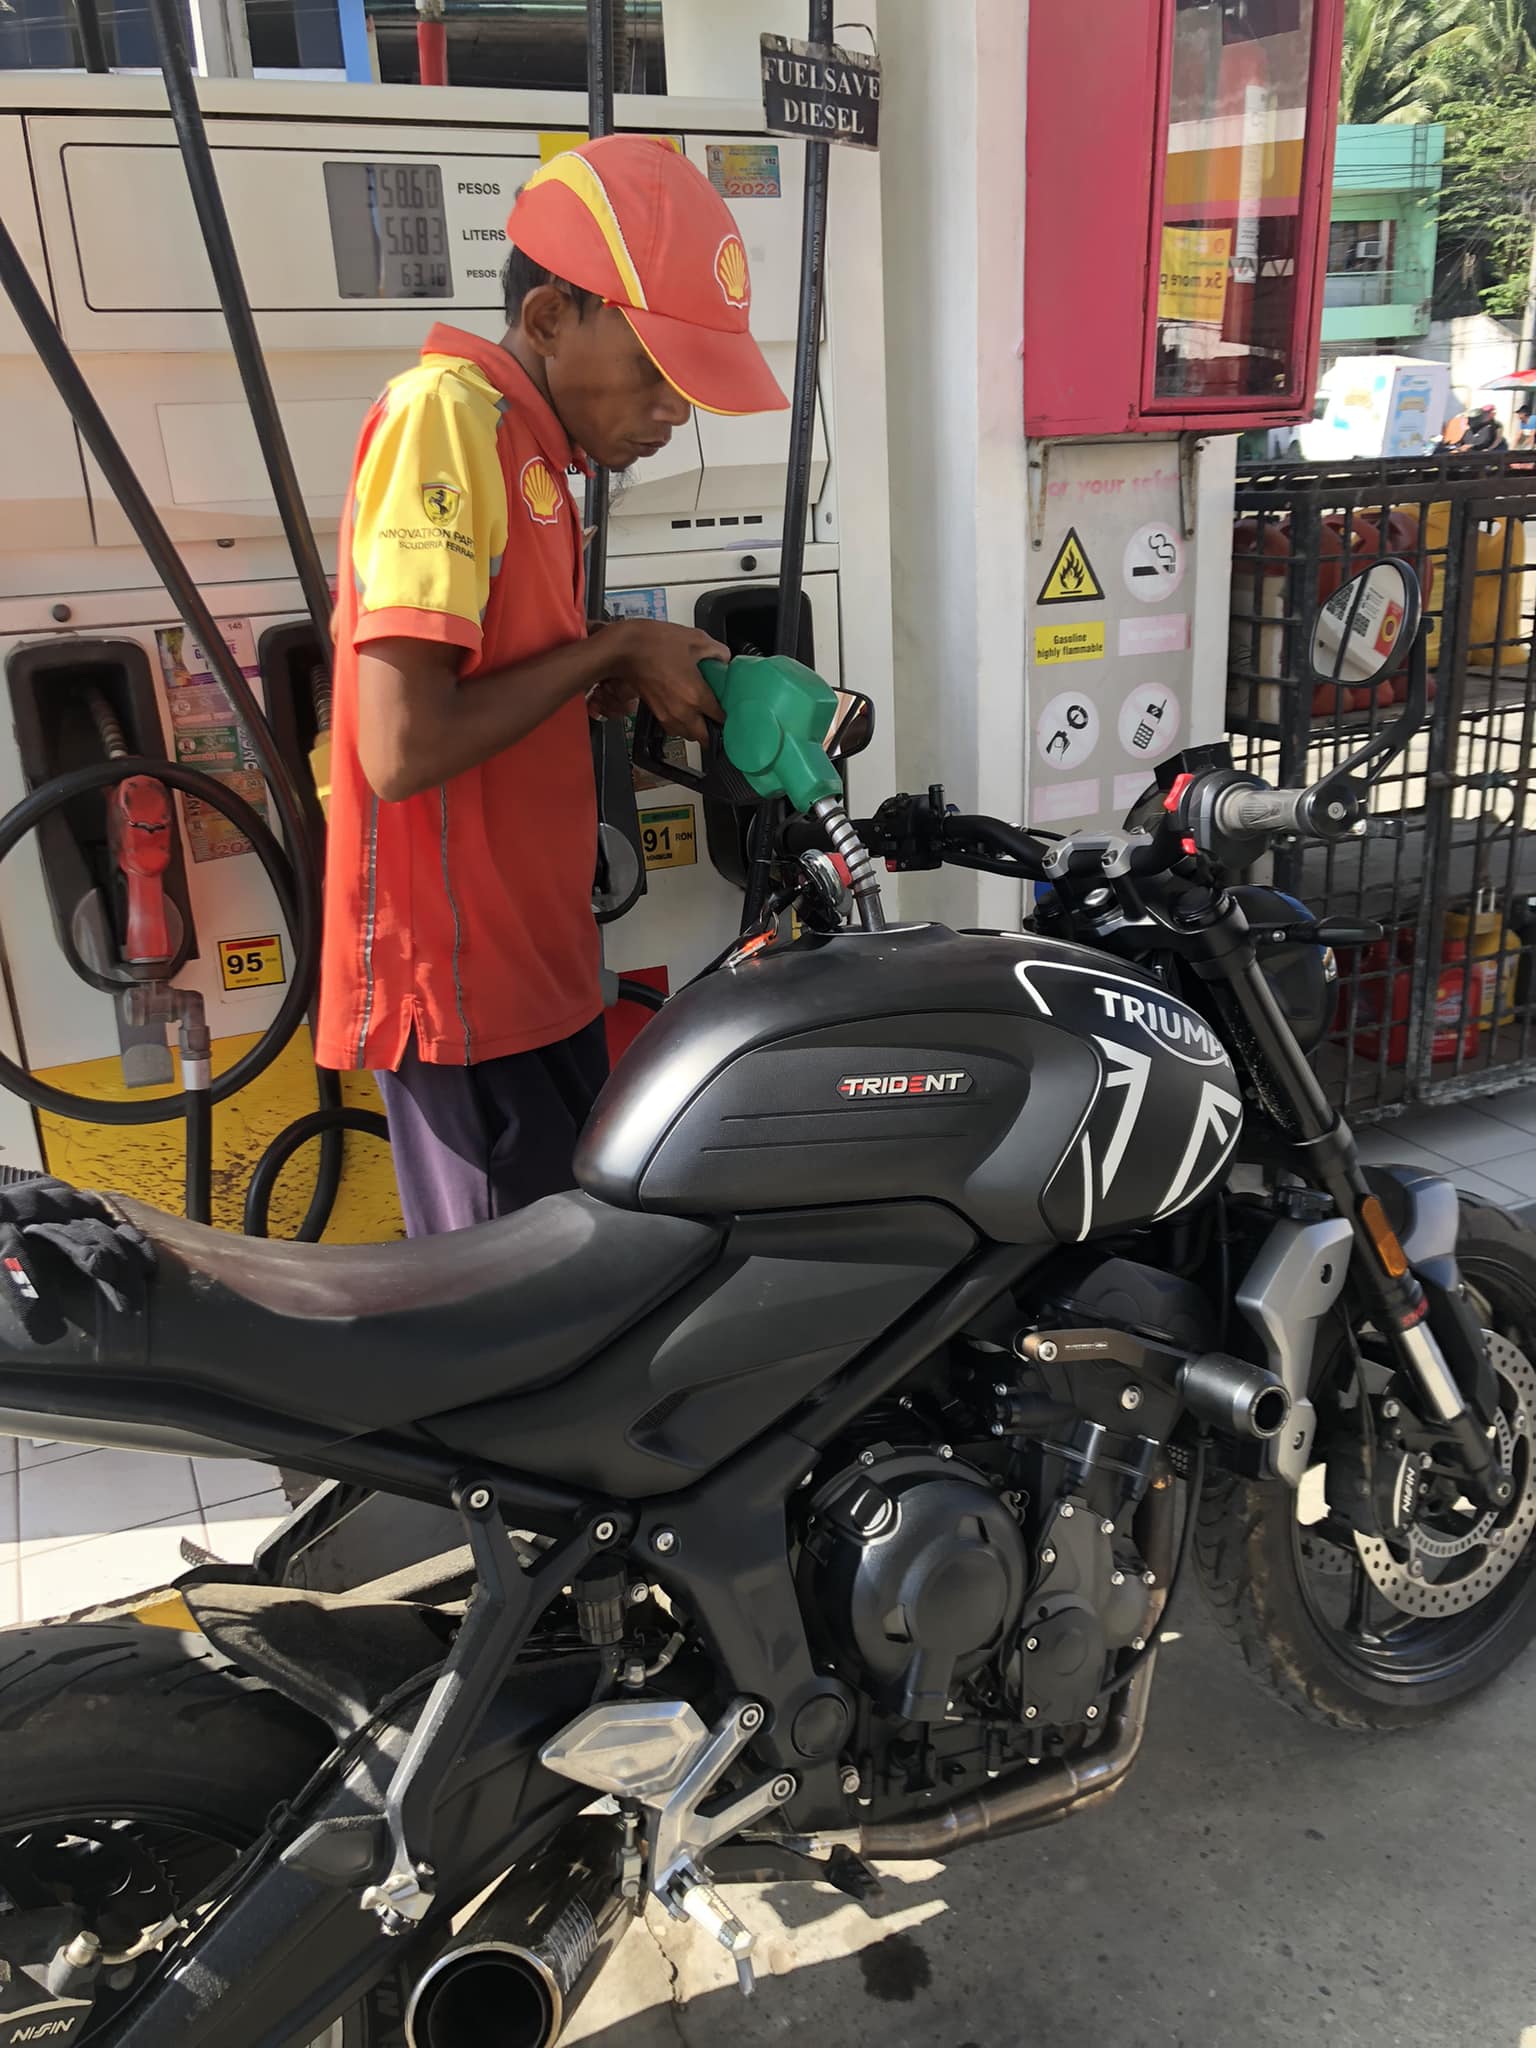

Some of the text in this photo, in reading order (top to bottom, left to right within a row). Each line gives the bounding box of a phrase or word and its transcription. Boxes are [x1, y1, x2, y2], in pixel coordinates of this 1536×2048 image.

[763, 56, 880, 100] FUELSAVE
[784, 98, 864, 134] DIESEL
[458, 182, 500, 195] PESOS
[730, 183, 778, 195] 2022
[462, 229, 507, 242] LITERS
[466, 269, 497, 279] PESOS
[1076, 479, 1126, 503] your
[1054, 633, 1087, 645] Gasoline
[1037, 642, 1103, 660] highly flammable
[643, 826, 692, 852] 91 RON
[226, 952, 264, 975] 95
[840, 1072, 965, 1096] TRIDENT
